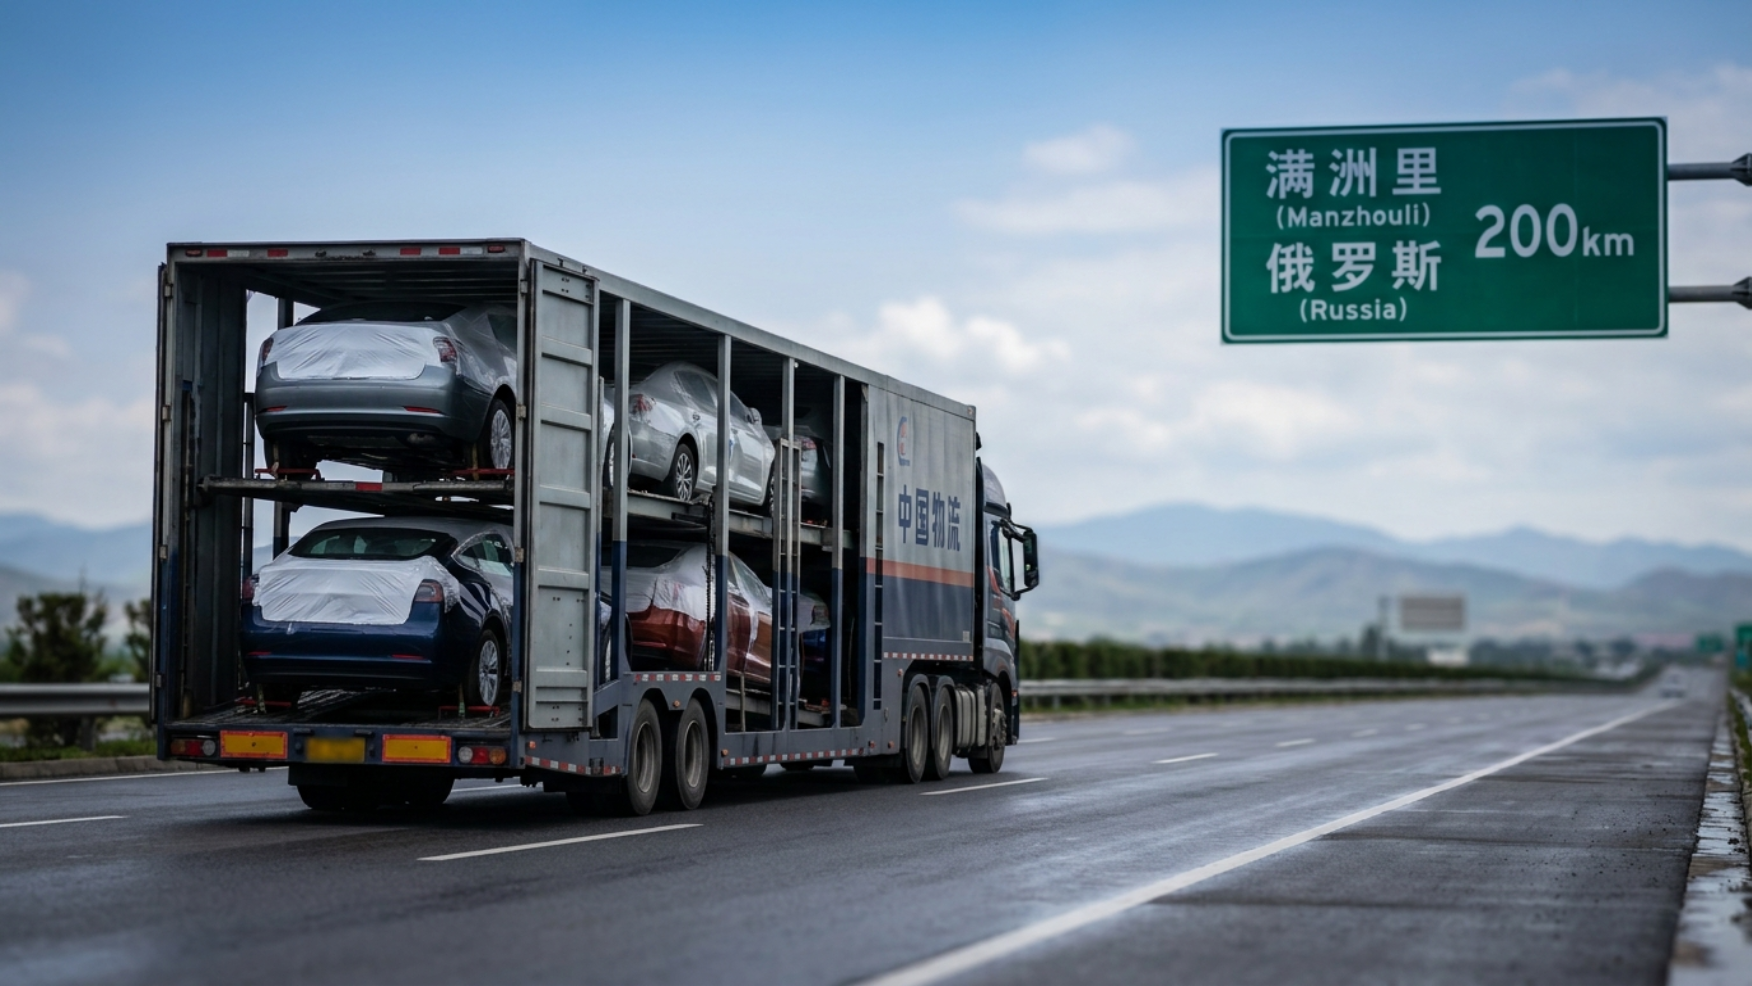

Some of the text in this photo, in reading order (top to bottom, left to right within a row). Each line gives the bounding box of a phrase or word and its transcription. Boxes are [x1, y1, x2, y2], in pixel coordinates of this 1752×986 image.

[1265, 147, 1442, 199] 满洲里
[1276, 203, 1430, 230] (Manzhouli)
[1265, 241, 1442, 294] 俄罗斯
[1300, 297, 1408, 323] (Russia)
[898, 484, 960, 551] 中国物流
